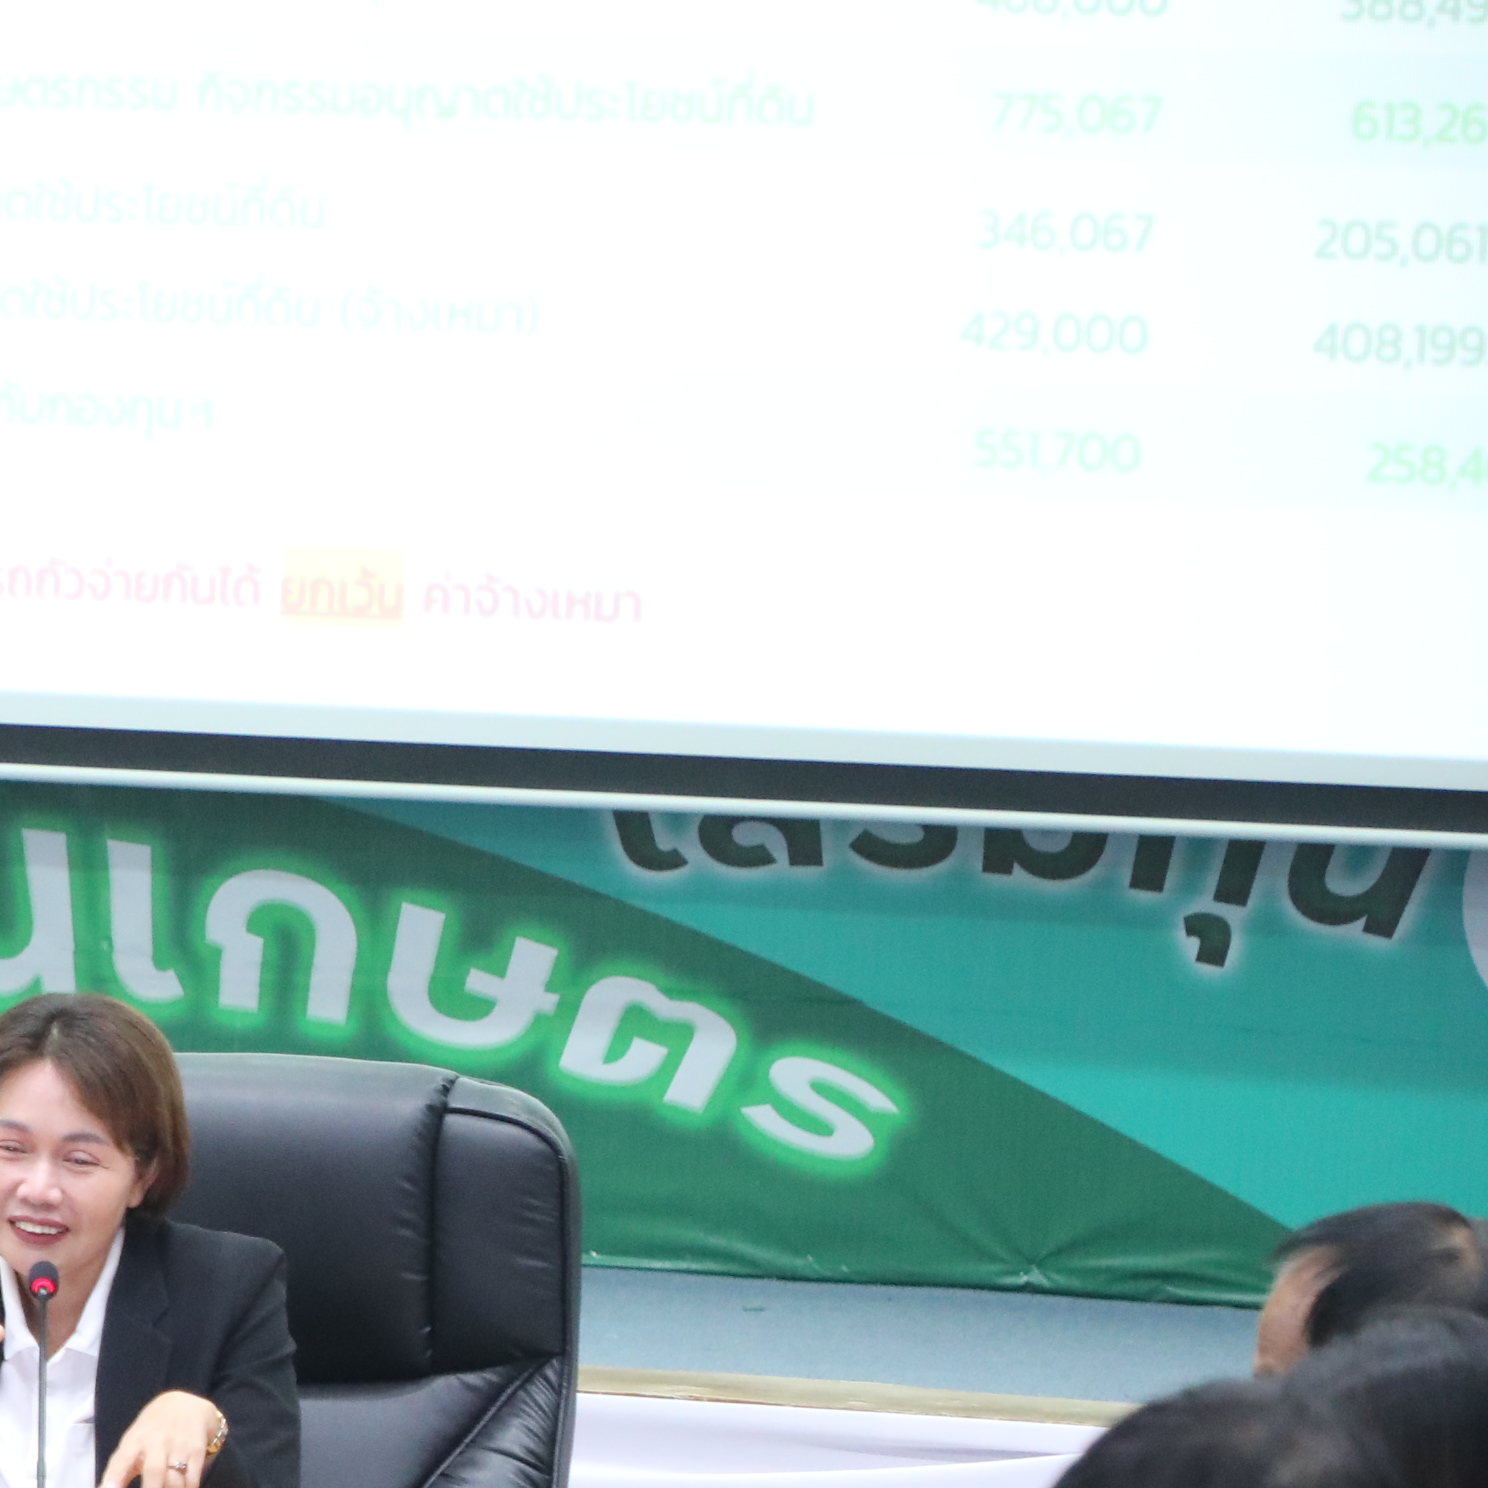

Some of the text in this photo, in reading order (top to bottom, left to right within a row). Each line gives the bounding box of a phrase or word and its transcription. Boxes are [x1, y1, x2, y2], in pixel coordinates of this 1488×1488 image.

[991, 90, 1165, 140] 775,067
[977, 208, 1157, 257] 346,067
[959, 309, 1150, 358] 429,000
[974, 426, 1144, 476] 551,700
[1364, 440, 1488, 492] 258,4
[280, 565, 405, 617] ยกเว้น
[423, 571, 643, 623] ค่าจ้างเหมา
